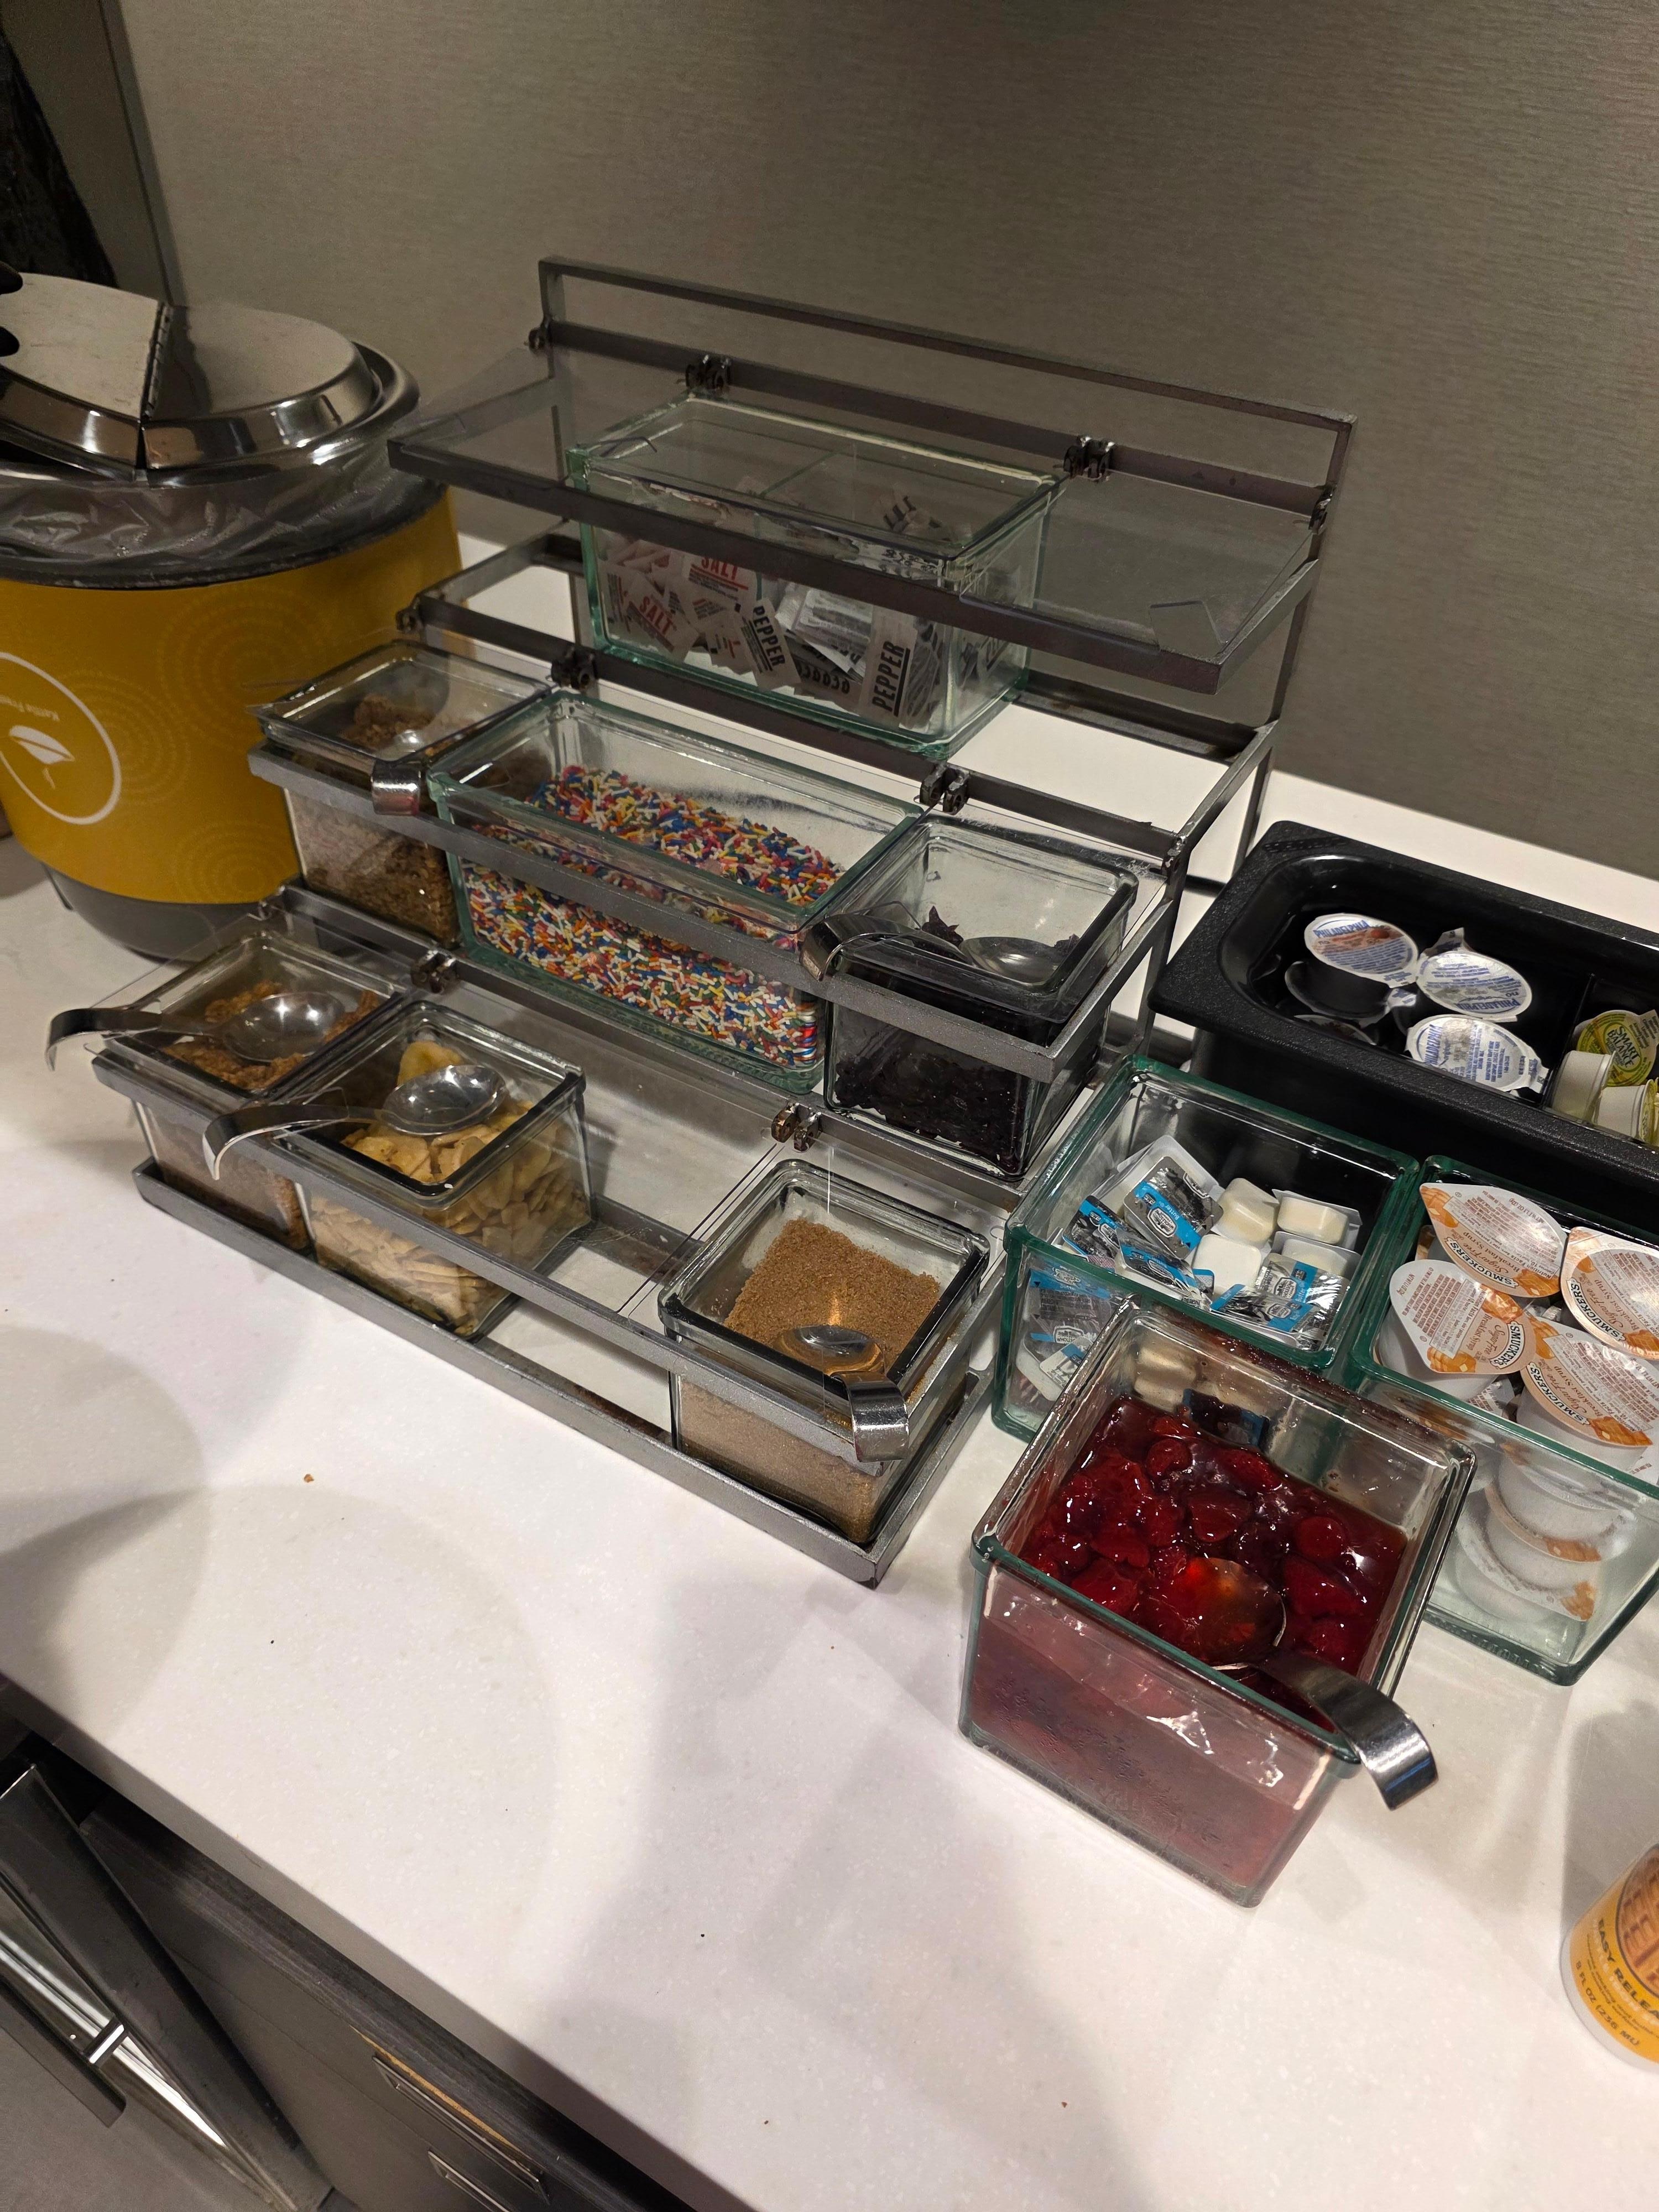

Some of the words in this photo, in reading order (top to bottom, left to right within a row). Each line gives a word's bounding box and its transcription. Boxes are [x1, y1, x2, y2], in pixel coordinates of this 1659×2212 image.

[639, 596, 673, 636] SALT
[753, 605, 785, 666] PEPPER
[872, 640, 904, 712] PEPPER
[1313, 920, 1370, 938] PHILADELPHIA
[1454, 998, 1521, 1010] PHILADELPHIA
[1425, 1024, 1443, 1066] PHILADELPHIA
[1607, 1030, 1635, 1068] BALANCE
[1615, 1026, 1641, 1060] SMART
[1165, 1205, 1180, 1220] Butter
[1462, 1232, 1484, 1250] Syrup
[1450, 1242, 1512, 1285] SMUCKER'S
[1485, 1248, 1519, 1272] Breakfast
[1510, 1254, 1526, 1266] Facts
[1295, 1288, 1306, 1302] Butter
[1594, 1279, 1612, 1300] Syrup
[1571, 1282, 1619, 1336] SMUCKER'S
[1609, 1300, 1639, 1330] Breakfast
[1637, 1313, 1650, 1327] Facts
[1474, 1313, 1492, 1336] Breakfast
[1493, 1326, 1521, 1366] SMUCKER'S
[1553, 1365, 1573, 1387] Syrup
[1531, 1365, 1583, 1421] SMUCKER'S
[1572, 1386, 1603, 1417] Breakfast
[1600, 1401, 1615, 1415] Facts
[1598, 1919, 1615, 1963] EASY
[1585, 1987, 1597, 2004] OZ
